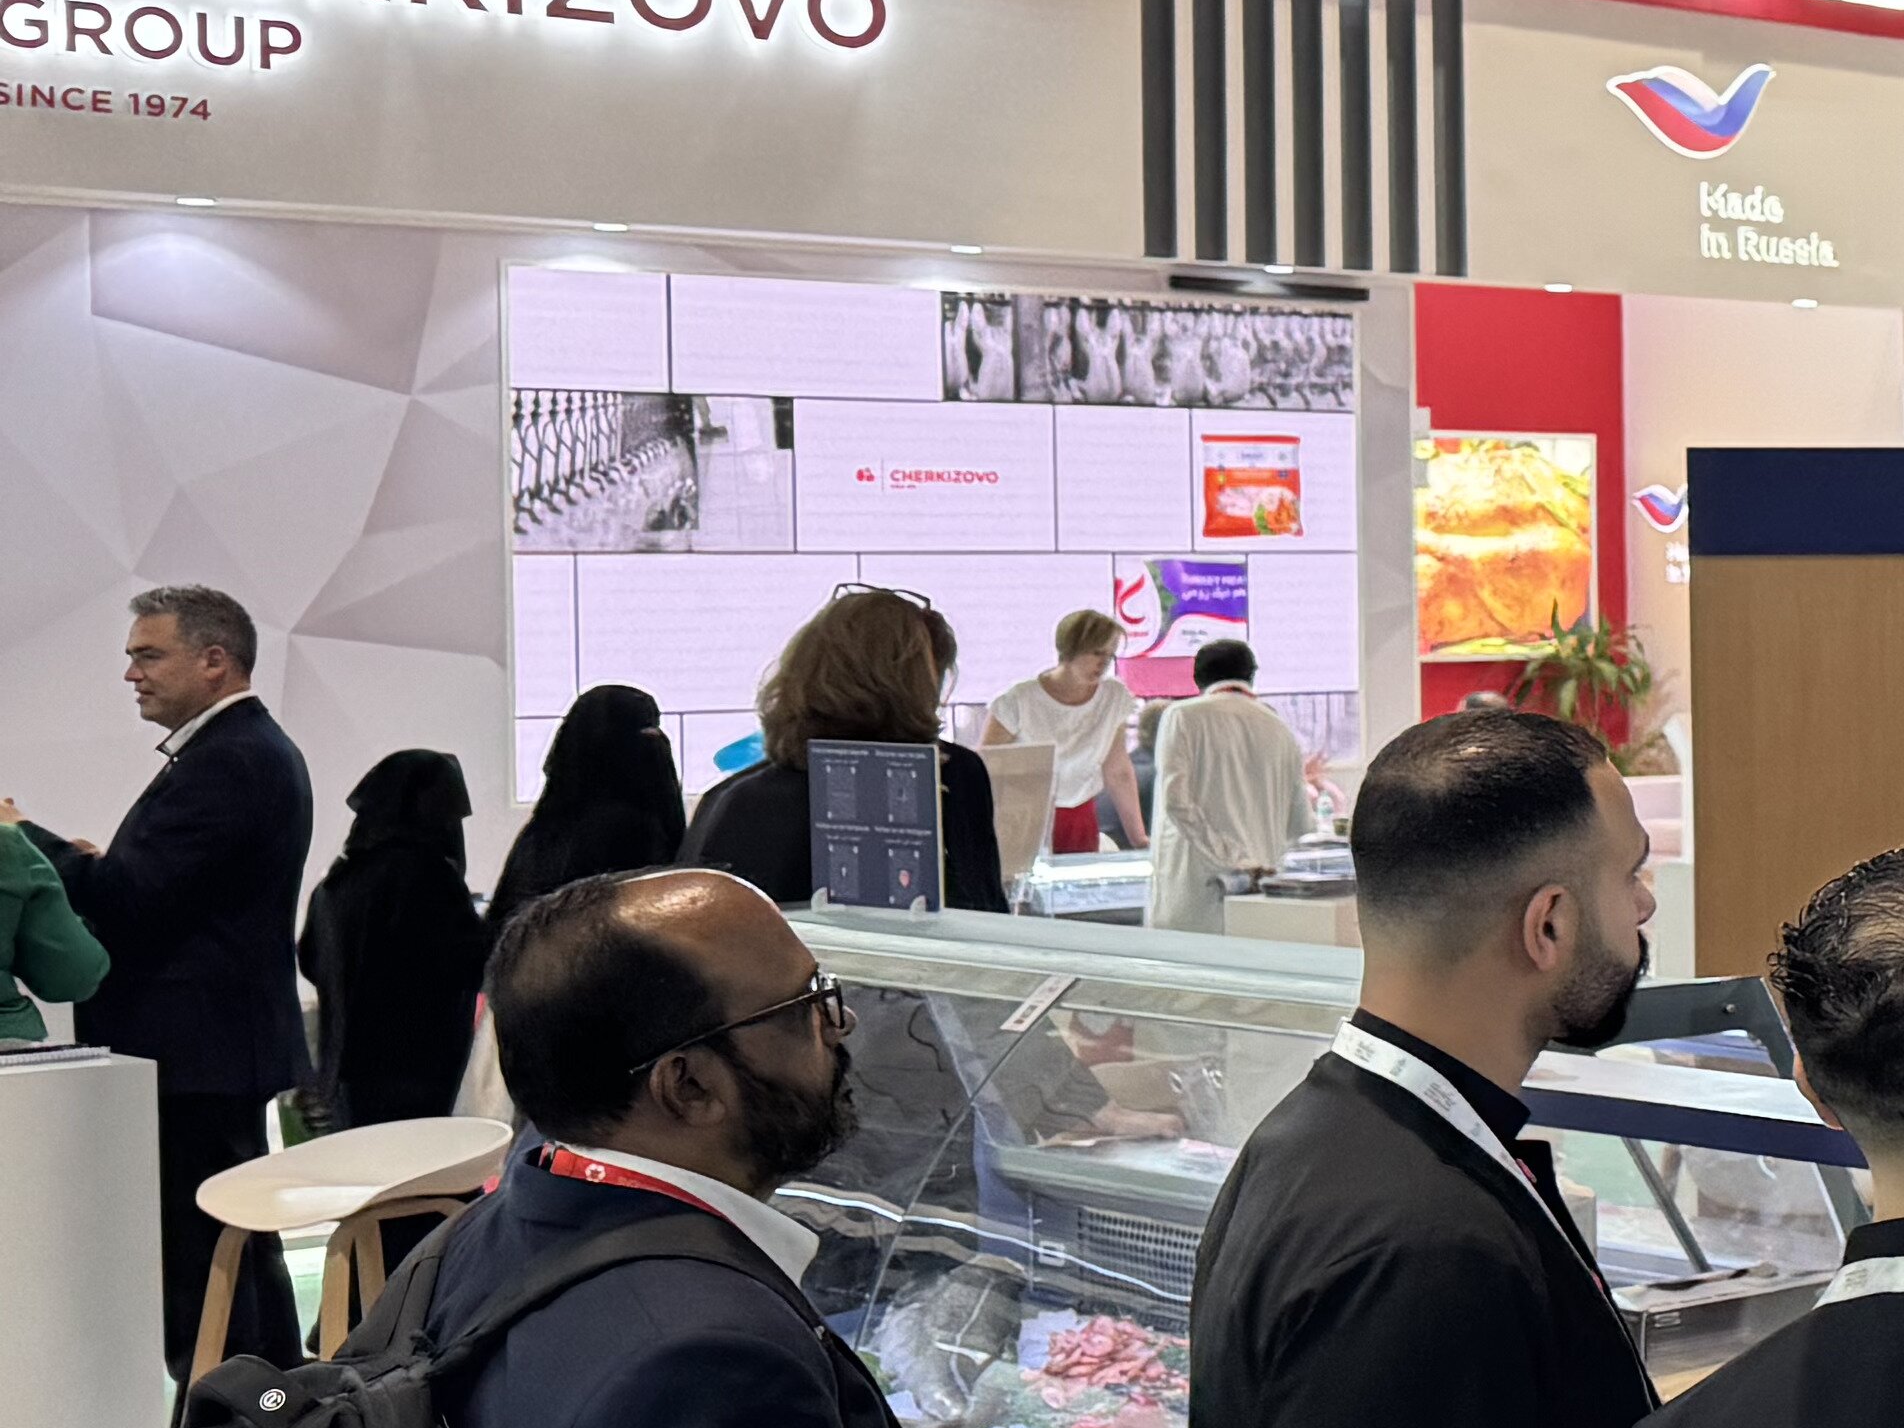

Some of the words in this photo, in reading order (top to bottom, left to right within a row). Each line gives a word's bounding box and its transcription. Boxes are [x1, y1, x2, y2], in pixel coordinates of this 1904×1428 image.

[127, 92, 212, 121] 1974
[1736, 225, 1840, 268] Russia
[889, 469, 1000, 484] CHERKIZOVO
